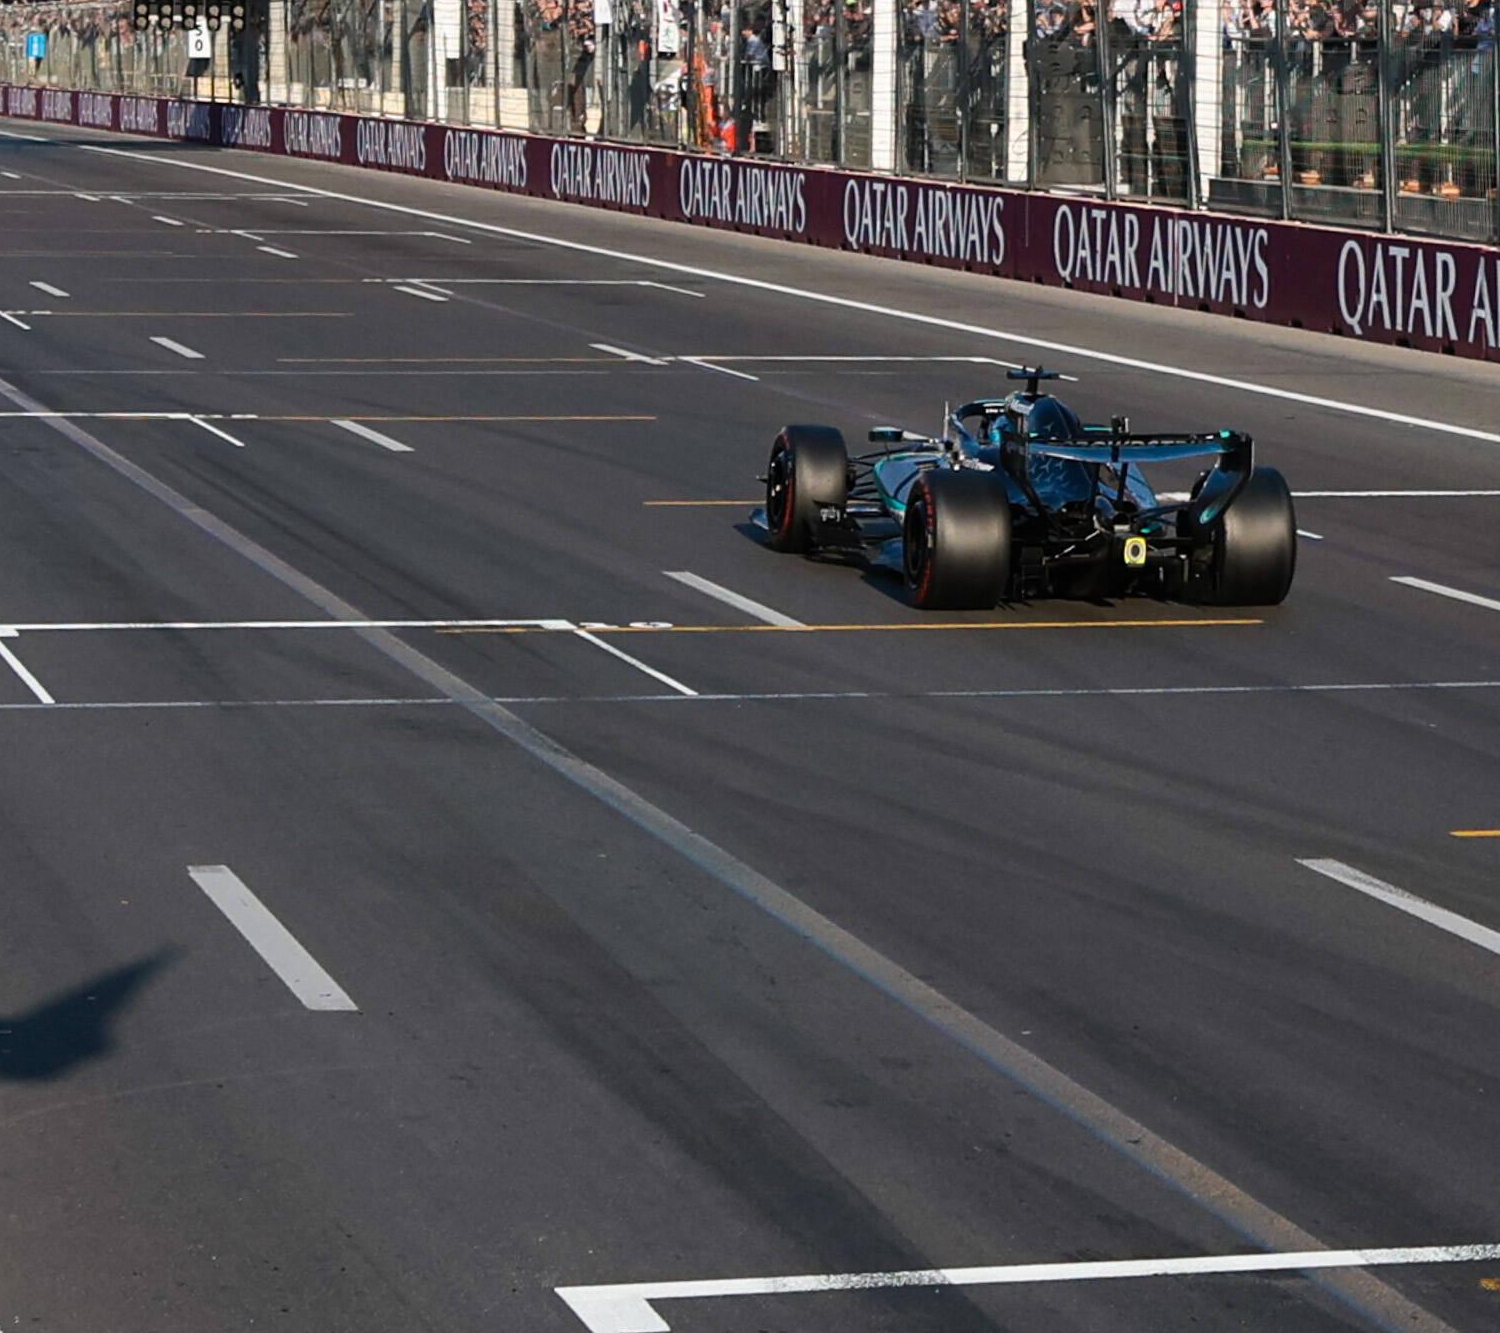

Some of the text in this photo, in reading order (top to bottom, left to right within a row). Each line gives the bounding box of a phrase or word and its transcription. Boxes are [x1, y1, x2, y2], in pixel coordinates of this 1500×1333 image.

[357, 119, 426, 170] QATAR AIRWAYS
[444, 129, 527, 187] QATAR AIRWAYS
[550, 142, 650, 207] QATAR AIRWAYS
[680, 159, 806, 233] QATAR AIRWAYS
[844, 179, 1005, 266] QATAR AIRWAYS
[1053, 204, 1269, 309] QATAR AIRWAYS
[1338, 240, 1457, 341] QATAR
